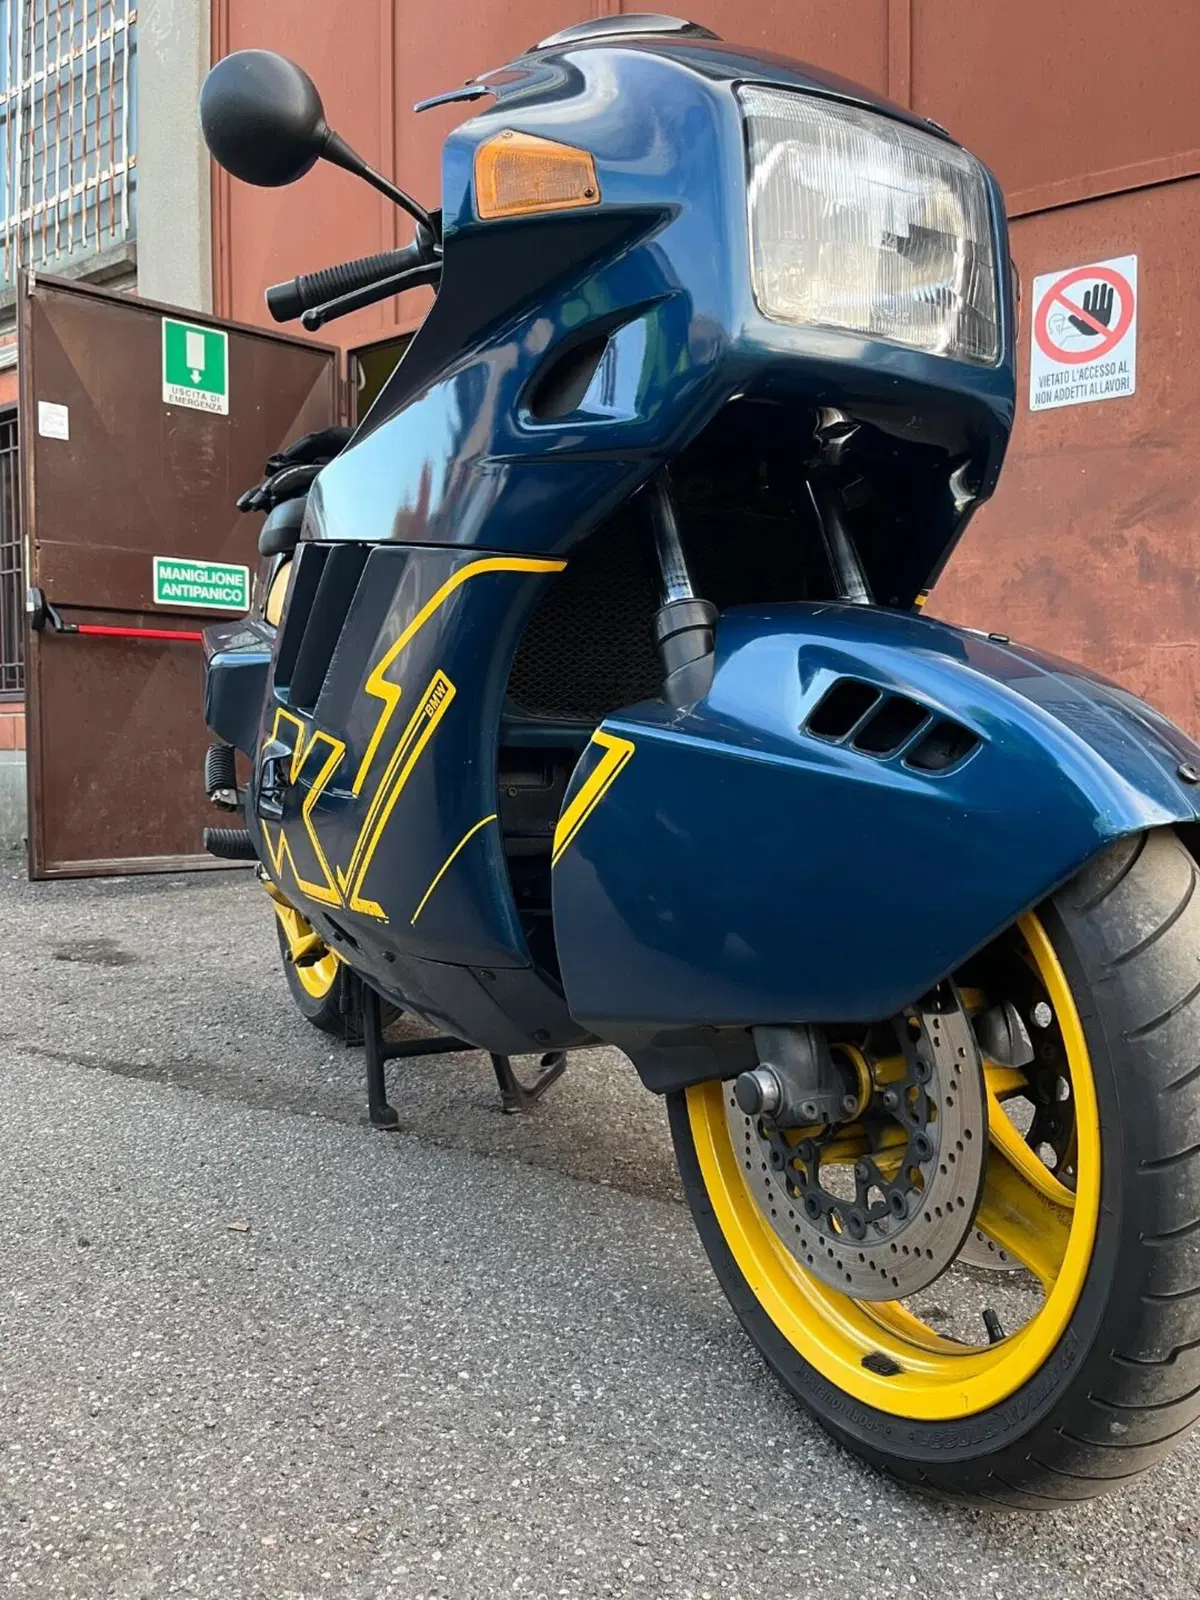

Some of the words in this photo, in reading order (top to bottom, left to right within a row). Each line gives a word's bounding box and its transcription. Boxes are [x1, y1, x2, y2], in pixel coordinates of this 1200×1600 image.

[1039, 369, 1070, 388] VIETATO
[1072, 362, 1116, 383] L'ACCESSO
[168, 394, 222, 411] EMERGENZA
[171, 386, 207, 400] USCITA
[1035, 391, 1052, 405] NON
[1053, 384, 1088, 402] ADDETTI
[159, 565, 243, 587] MANIGLIONE
[161, 582, 243, 602] ANTIPANICO
[424, 681, 446, 718] BMW
